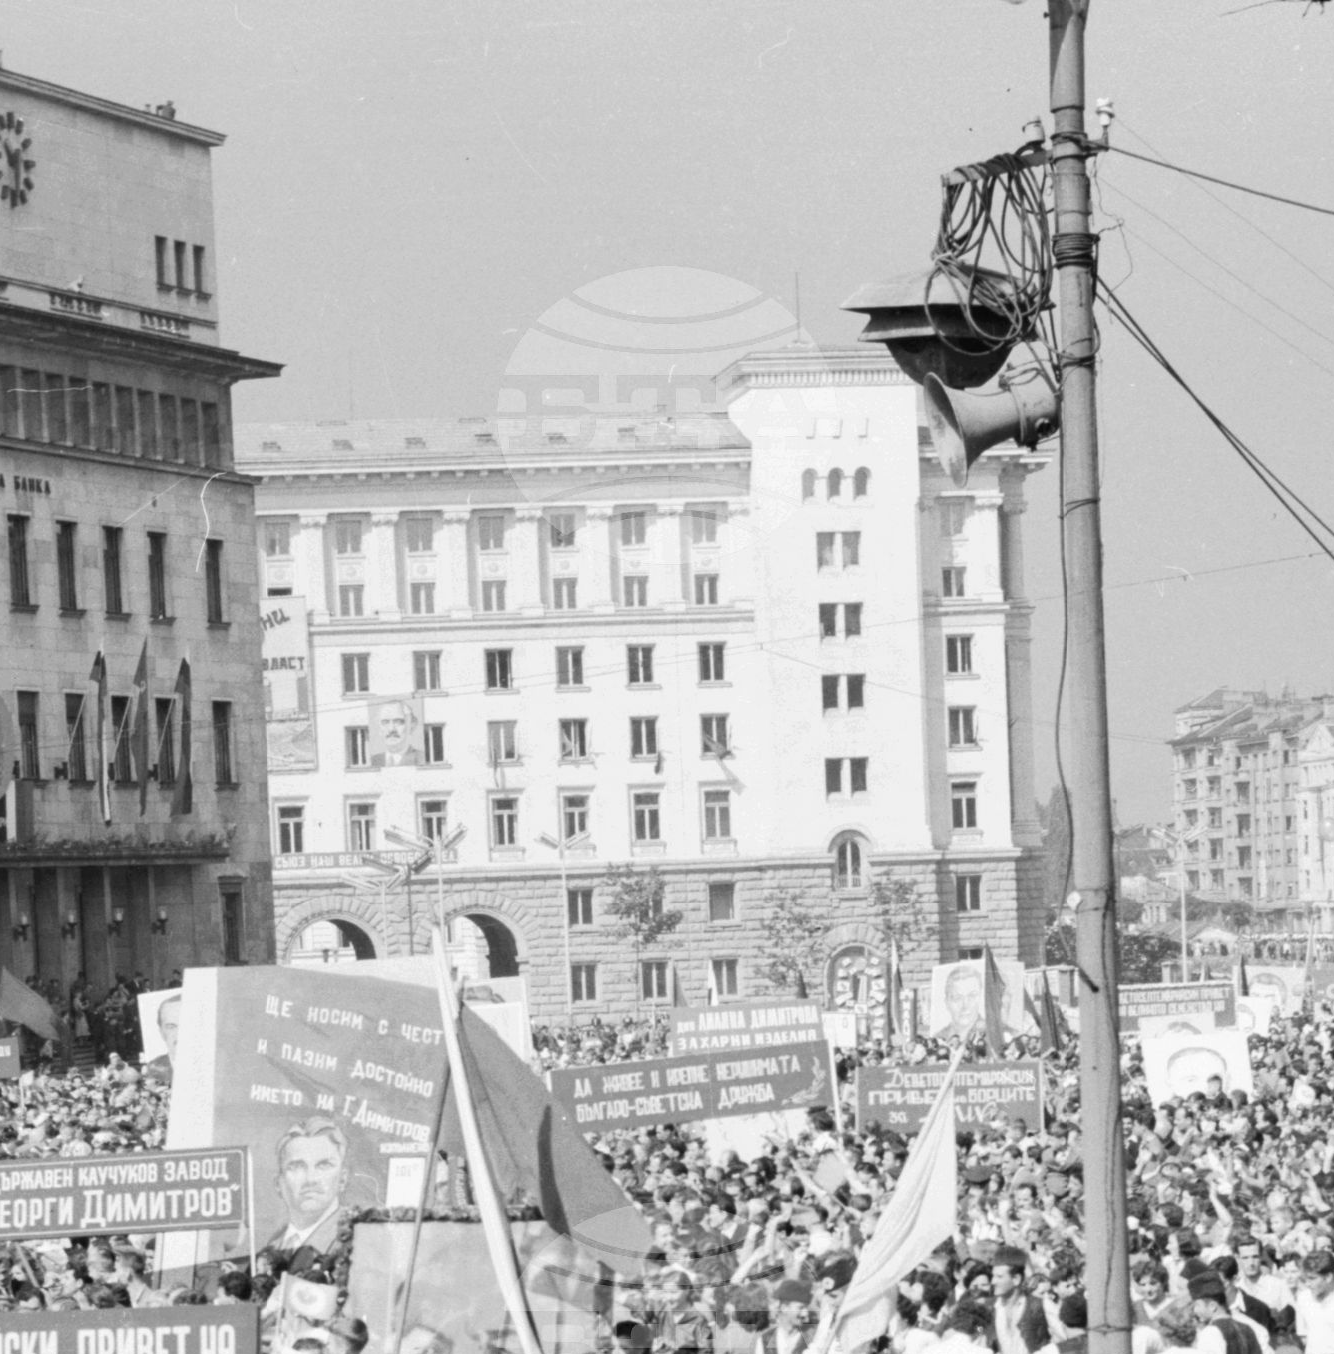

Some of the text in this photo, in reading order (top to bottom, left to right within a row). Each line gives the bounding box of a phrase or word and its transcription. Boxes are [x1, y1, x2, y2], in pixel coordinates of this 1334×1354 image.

[13, 475, 51, 495] БАНКА
[275, 855, 305, 869] СЪЮЗ
[310, 854, 334, 867] НАШ
[265, 994, 444, 1045] ЩЕ НОСИМ С ЧЕСТ
[677, 1028, 817, 1050] ЗАХАРНИ ИЗДЕЛИЯ
[257, 1038, 434, 1098] И ПАЗИМ ДОСТОЙНО
[250, 1083, 302, 1106] ИМЕТО
[317, 1093, 334, 1112] НА
[574, 1077, 592, 1098] ДА
[603, 1071, 645, 1094] ЖИВЕЕ
[651, 1070, 660, 1088] И
[718, 1082, 775, 1110] ДРУЖБА
[868, 1089, 940, 1105] ПРИВЕ
[968, 1087, 1035, 1103] БОРЦИТЕ
[78, 1163, 158, 1187] КАУЧУКОВ
[164, 1157, 229, 1182] ЗАВОД
